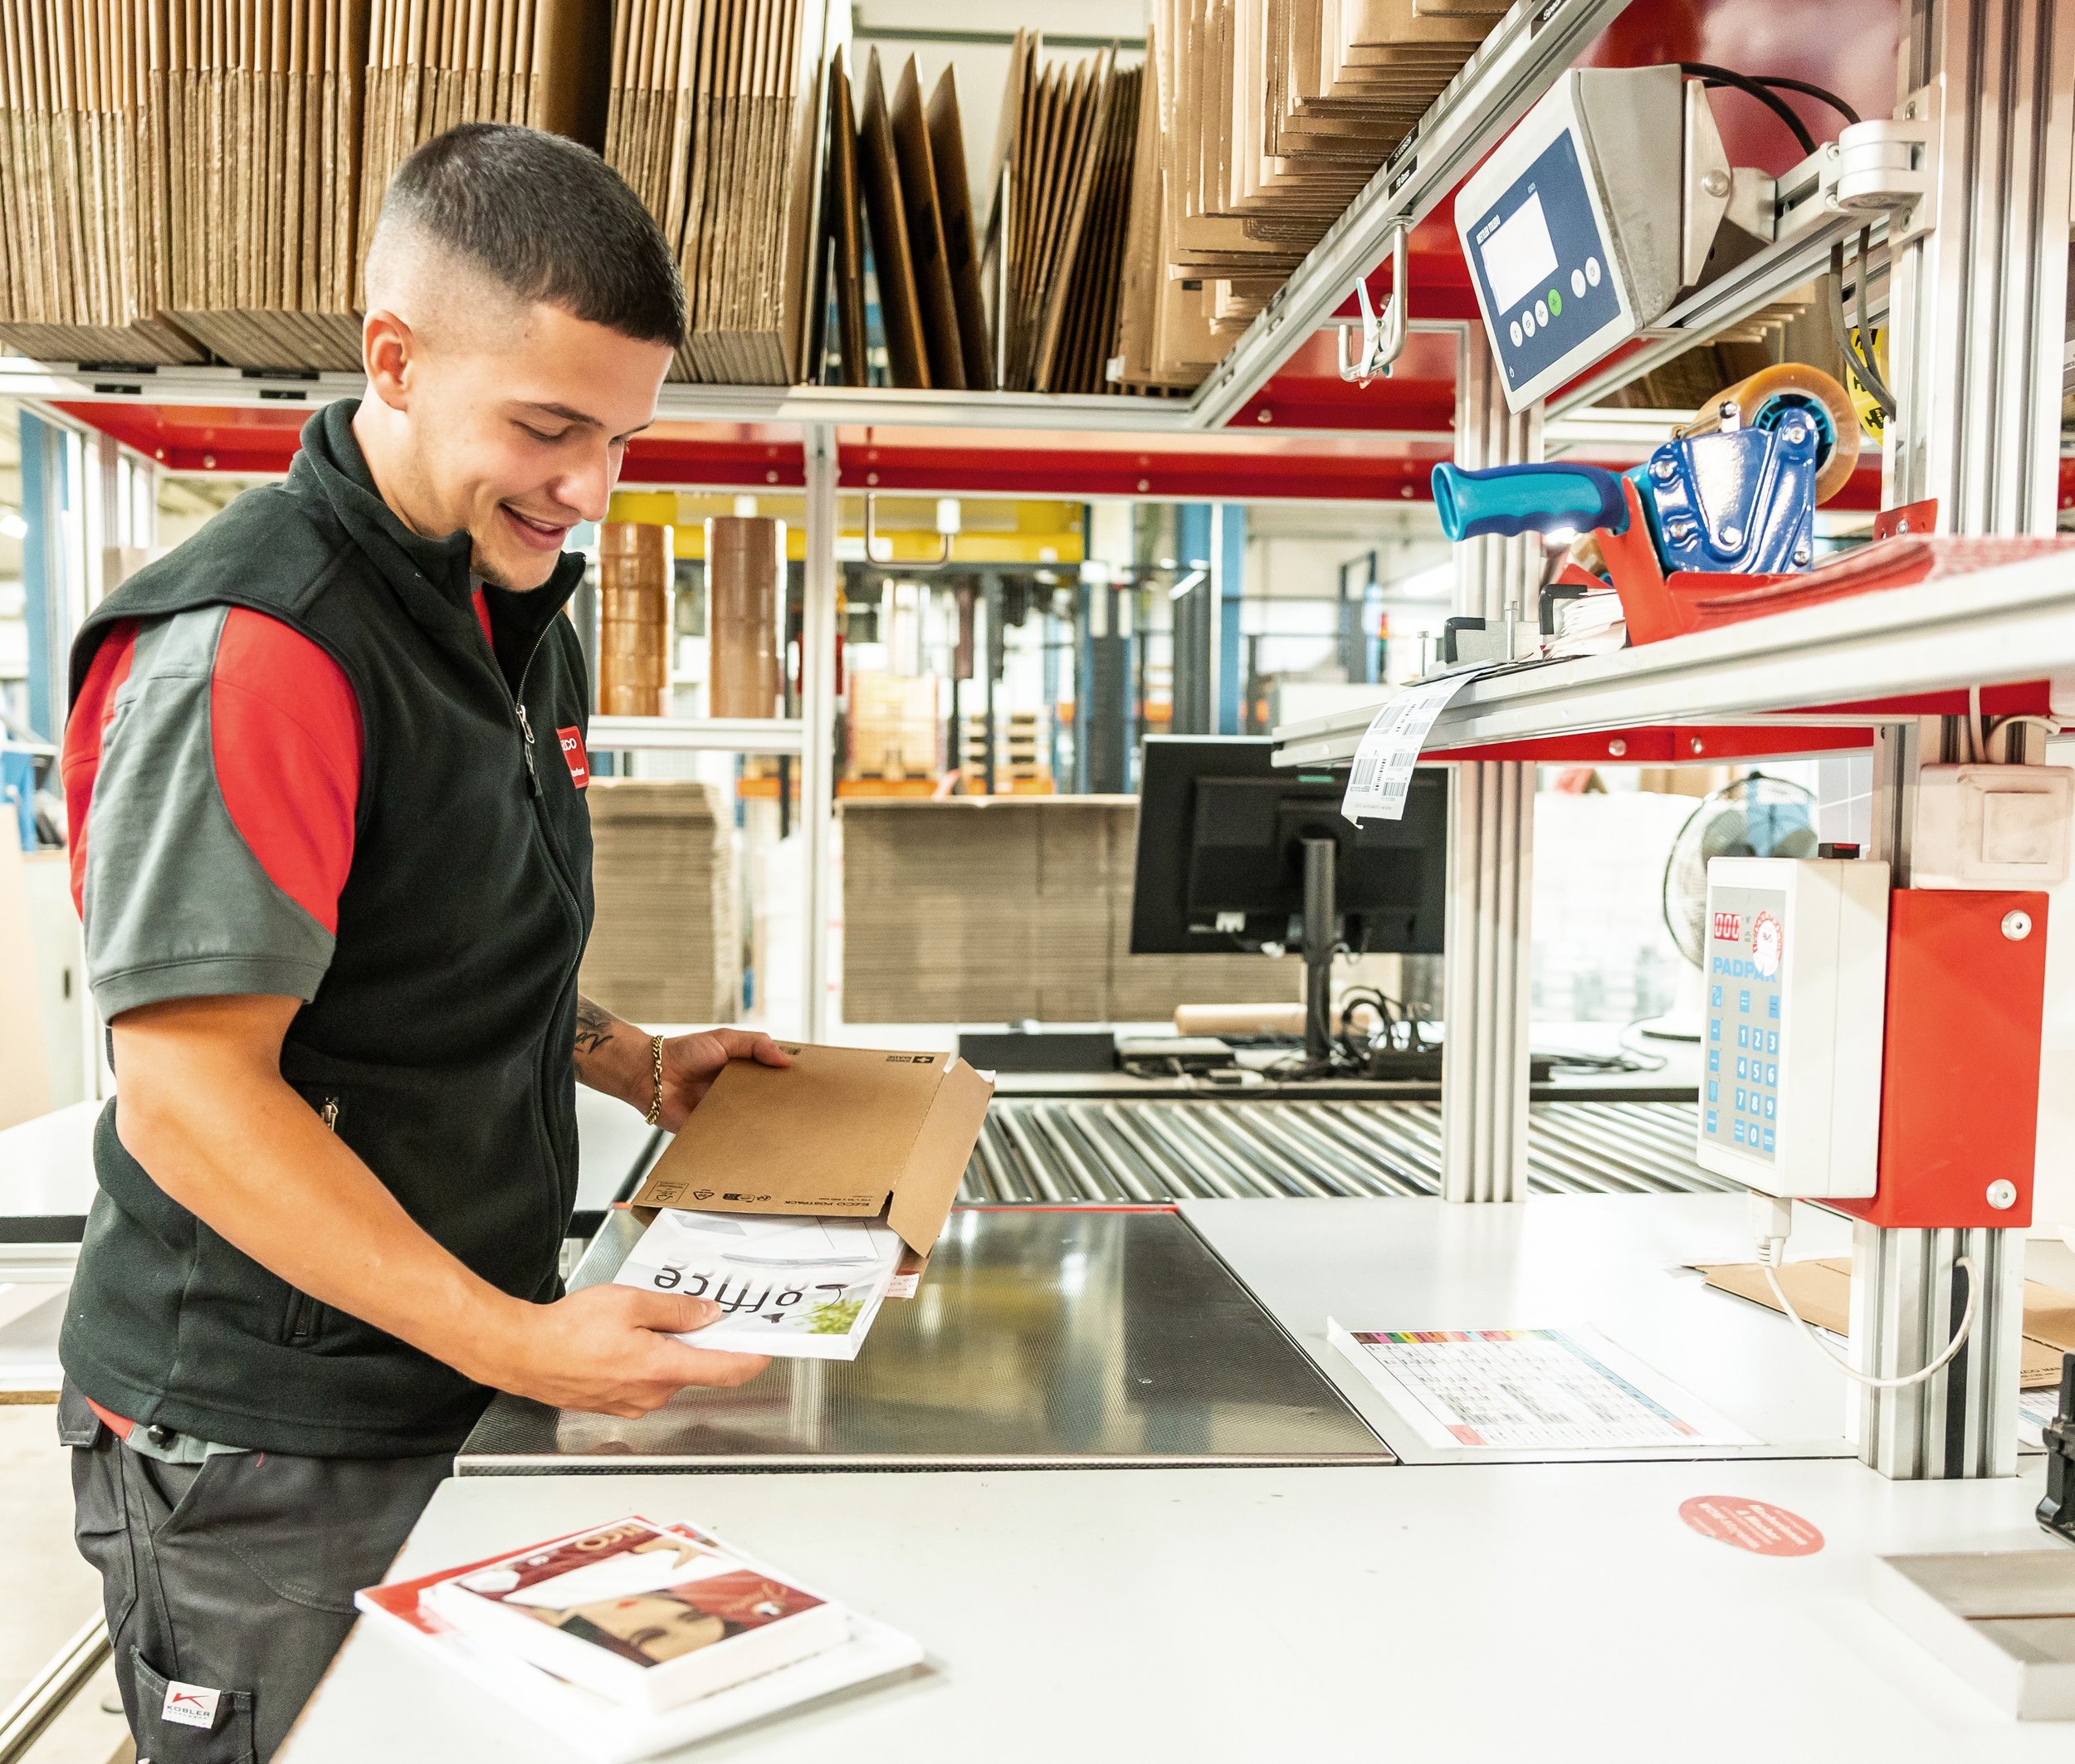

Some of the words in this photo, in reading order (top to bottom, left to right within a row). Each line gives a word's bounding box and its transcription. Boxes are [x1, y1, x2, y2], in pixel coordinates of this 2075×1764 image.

[1714, 913, 1741, 939] 000
[1741, 1029, 1745, 1043] 1
[1754, 1031, 1760, 1048] 2
[1769, 1034, 1776, 1050] 3
[1738, 1060, 1745, 1075] 4
[1753, 1063, 1760, 1078] 5
[1768, 1068, 1775, 1082] 6
[1737, 1092, 1744, 1106] 7
[1751, 1096, 1758, 1111] 8
[1766, 1100, 1774, 1116] 9
[1750, 1127, 1757, 1143] 0
[653, 1267, 803, 1313] office
[167, 1705, 211, 1718] KOBLER
